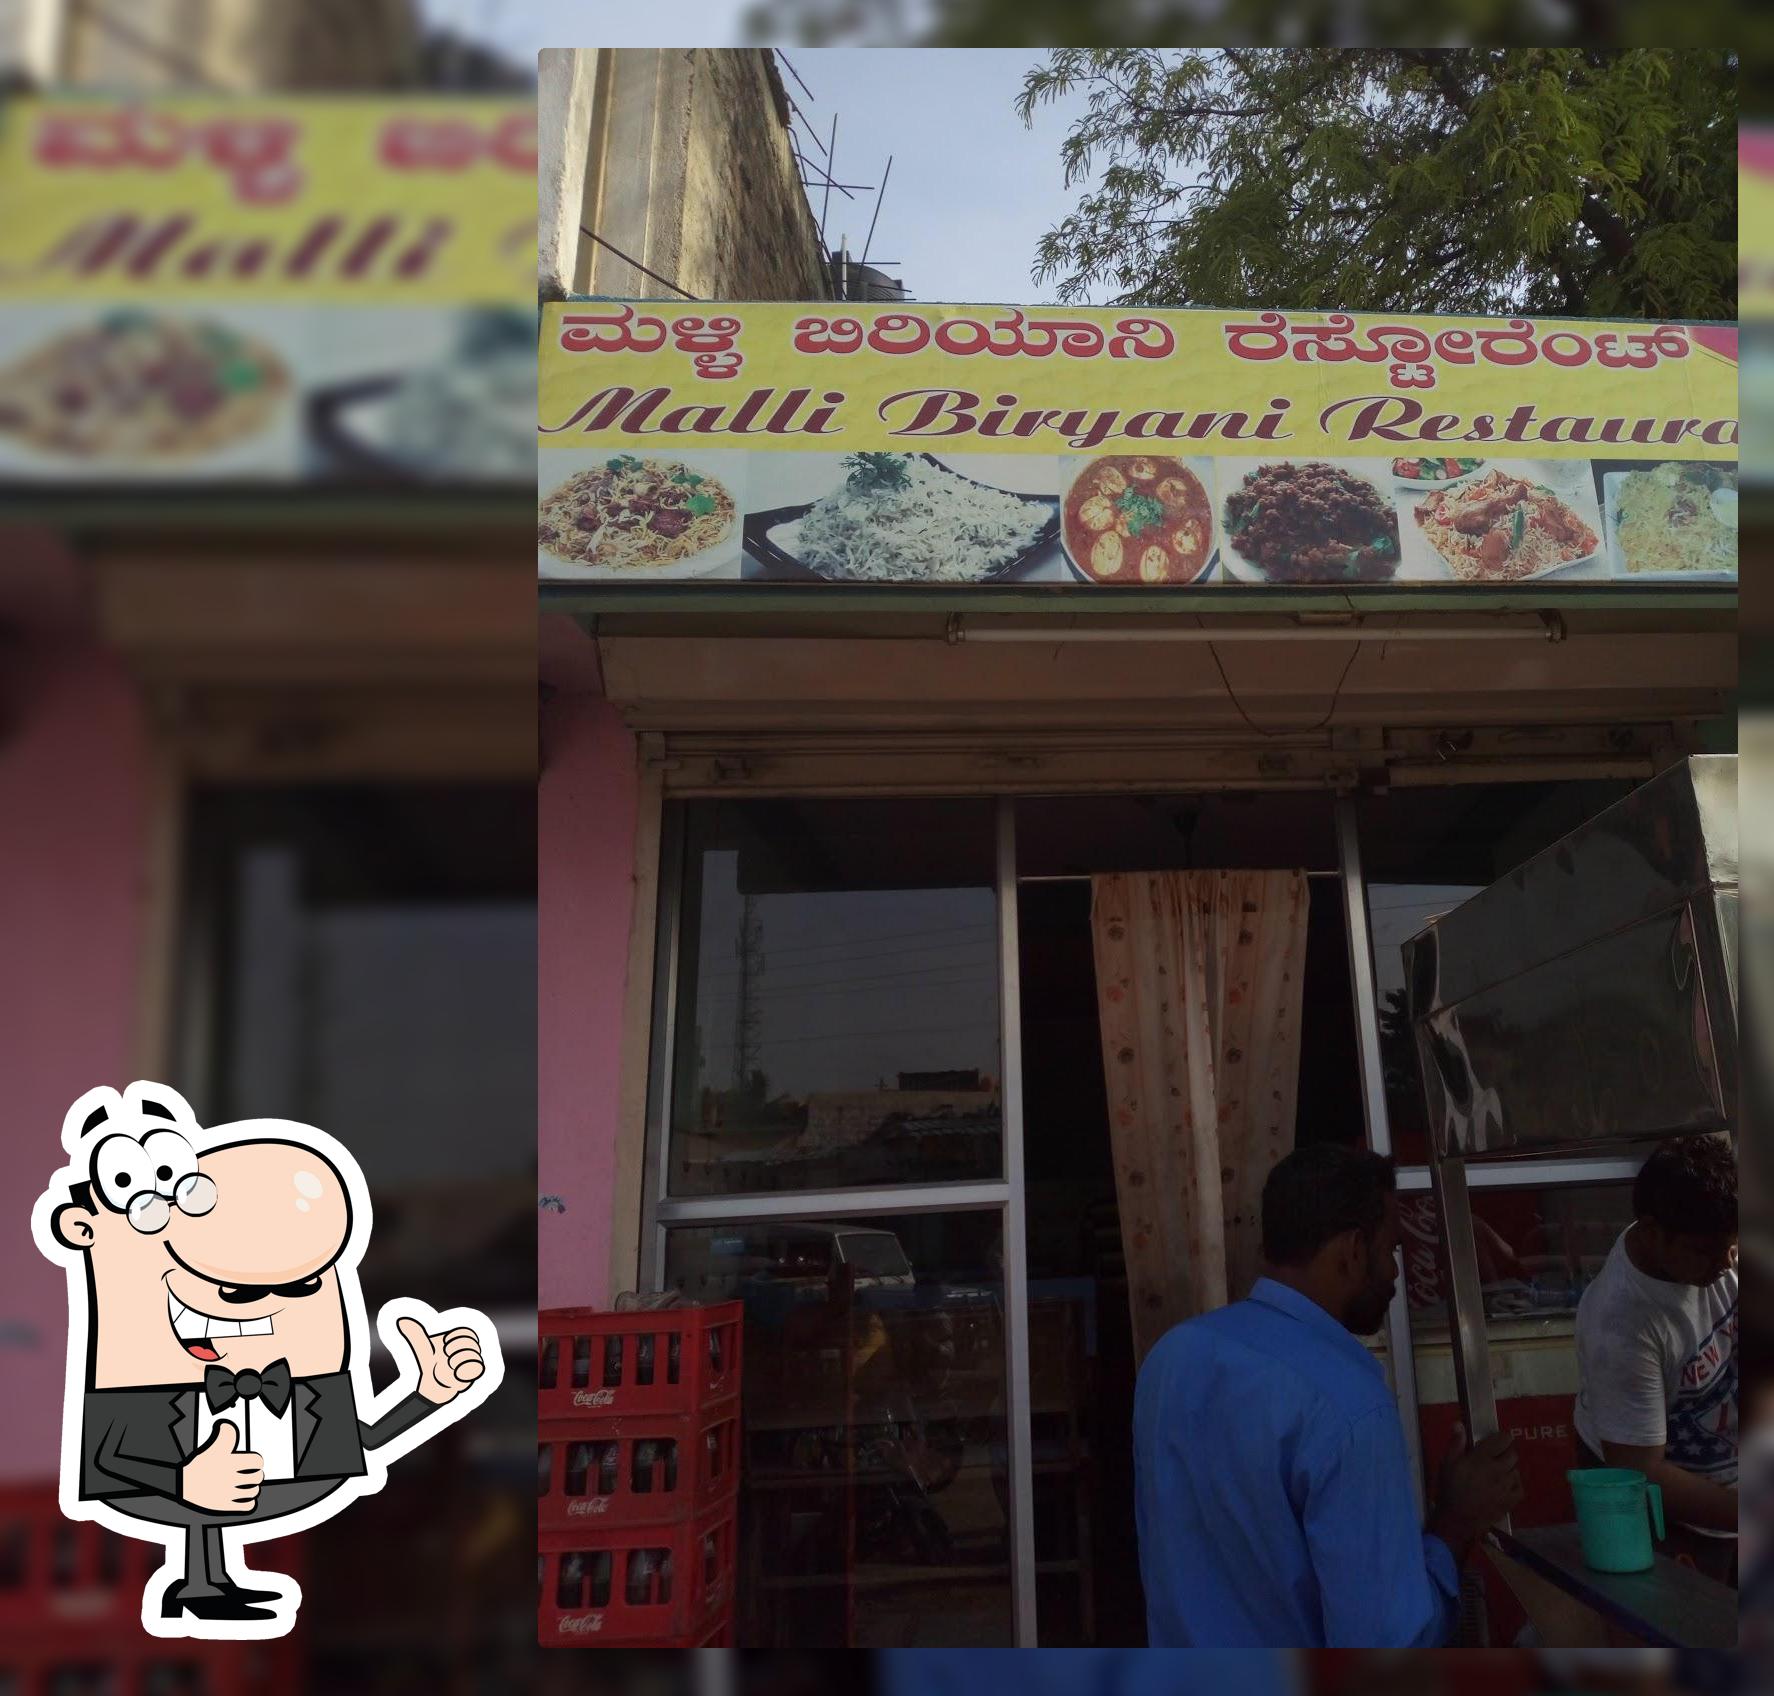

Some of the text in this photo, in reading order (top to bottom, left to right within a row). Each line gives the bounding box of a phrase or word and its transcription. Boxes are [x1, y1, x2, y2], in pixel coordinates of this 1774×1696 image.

[560, 304, 1691, 389] ಮಳ್ಳಿ ಬಿರಿಯಾನಿ ರೆಸ್ಟೋರೆಂಟ್
[538, 387, 845, 434] Malli
[879, 389, 1292, 448] Biryani
[1680, 1337, 1720, 1387] NEW
[1510, 1425, 1568, 1440] PURE
